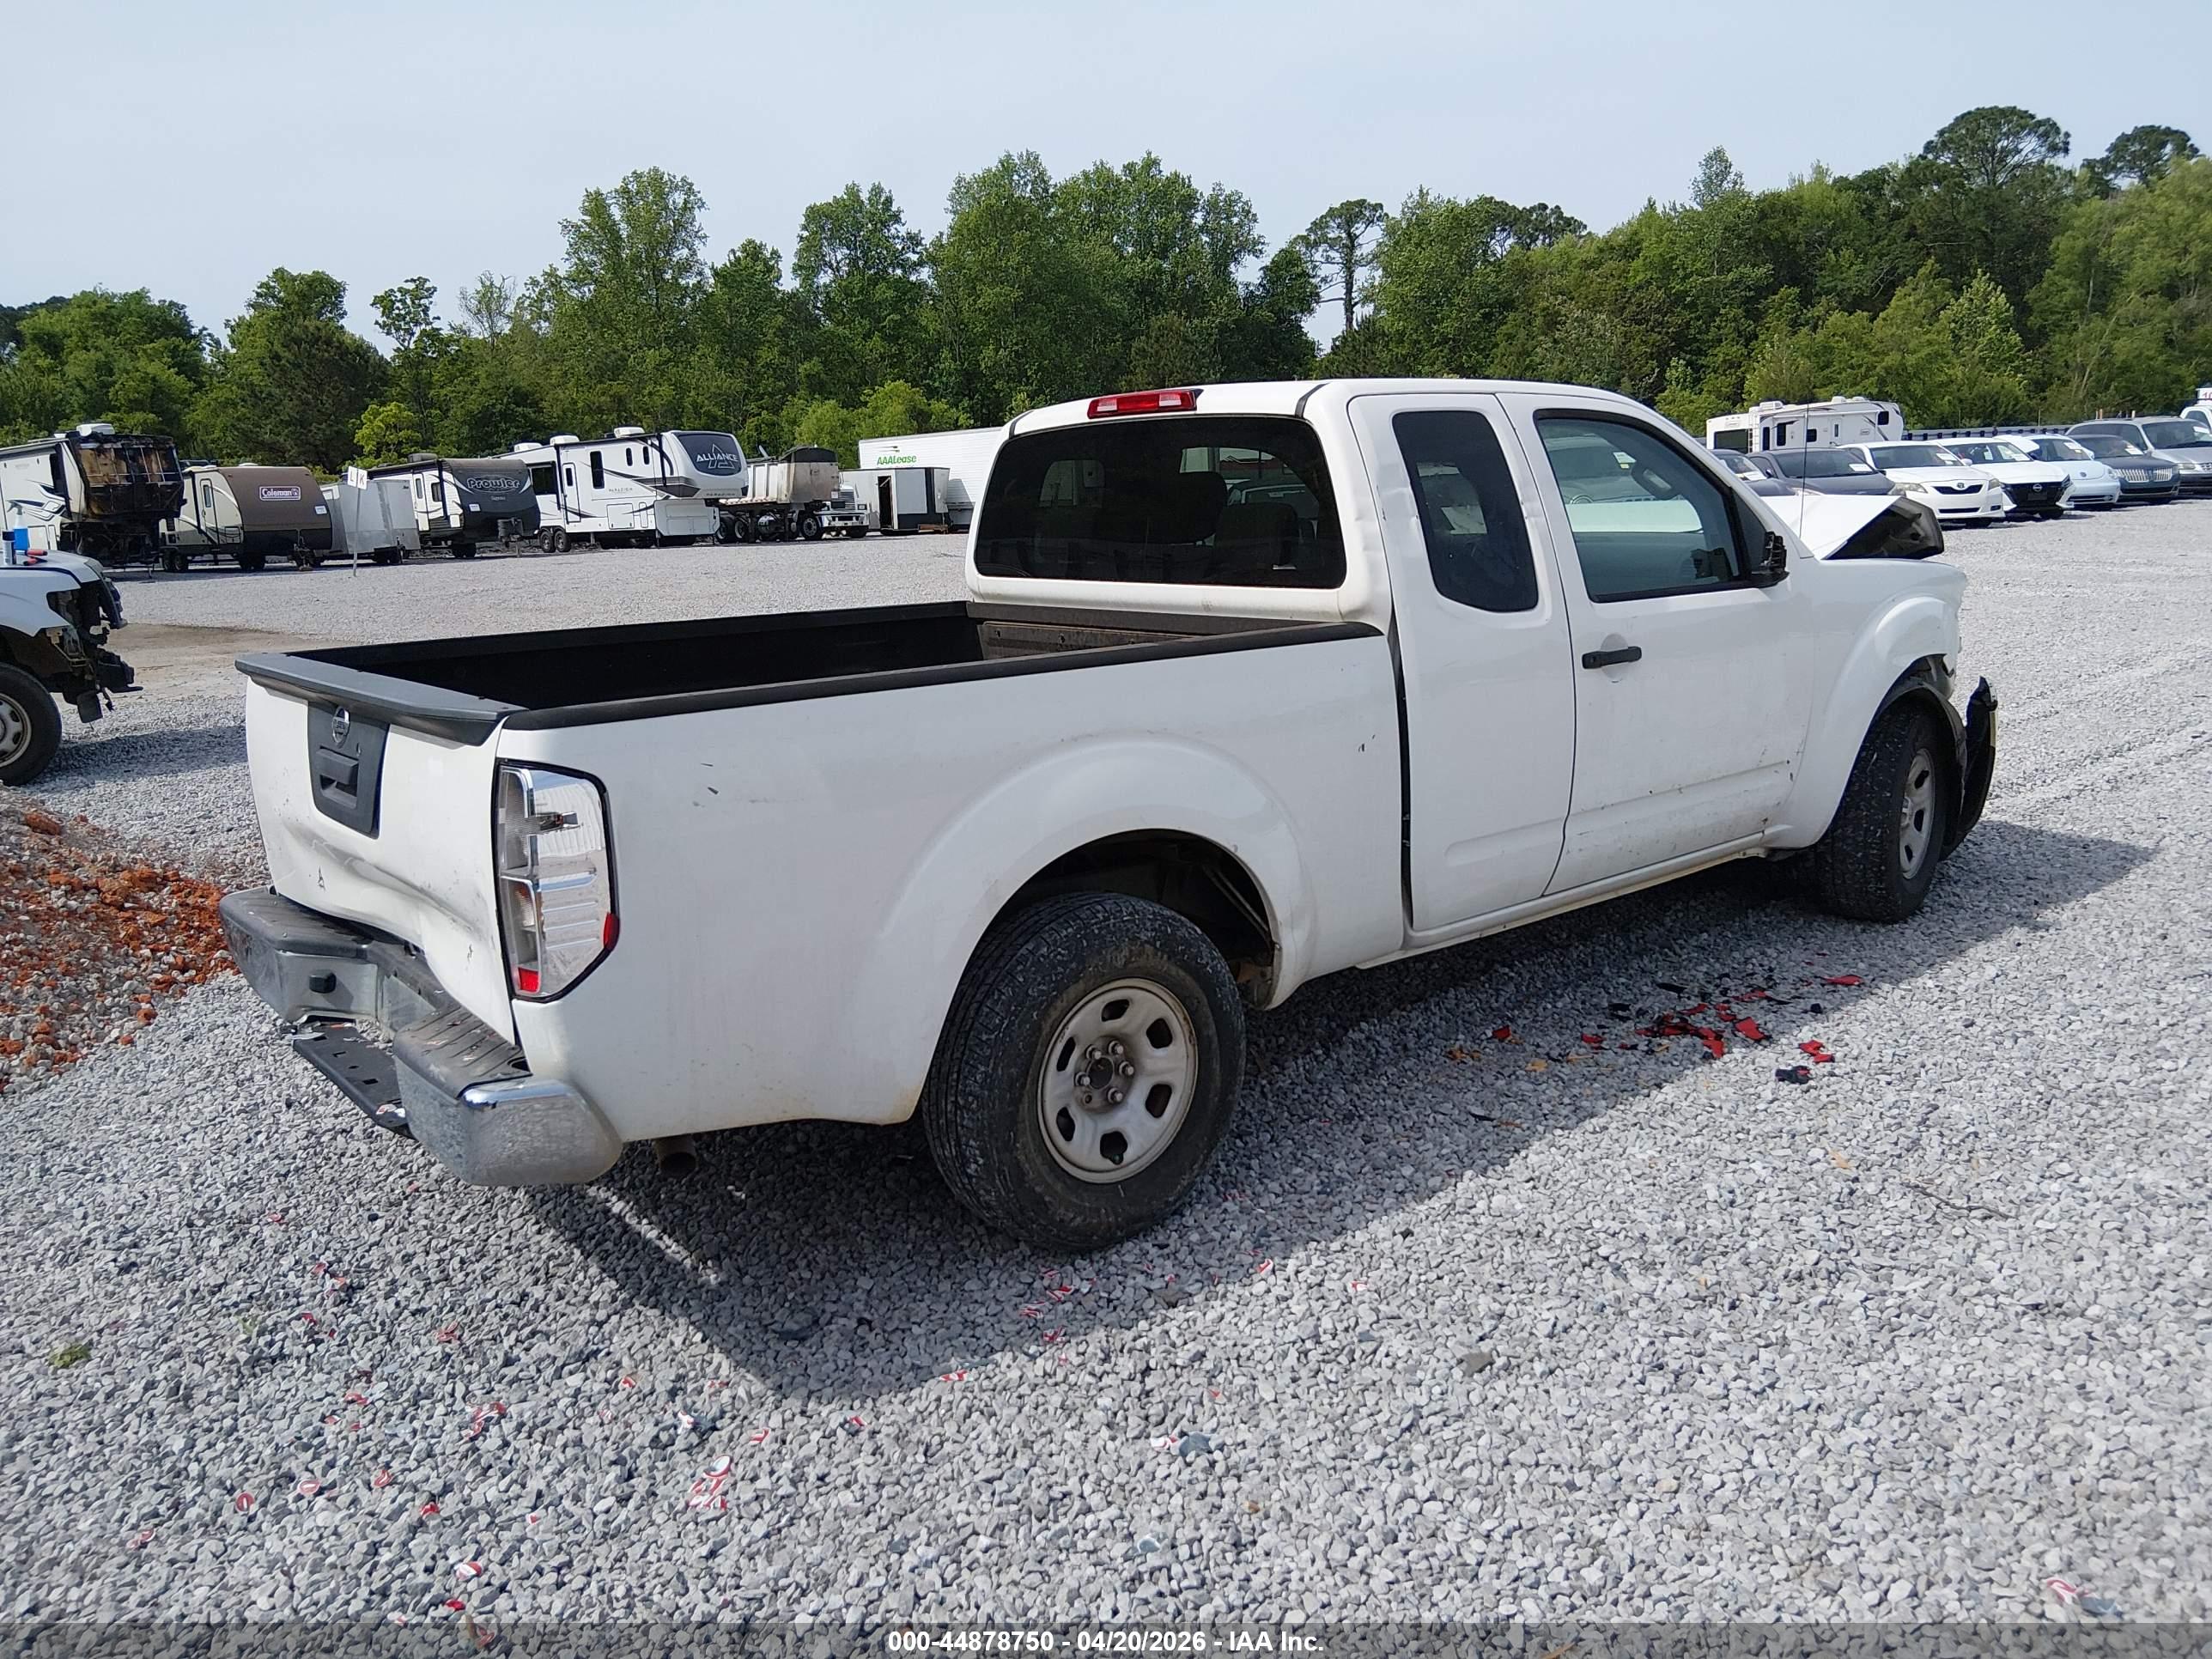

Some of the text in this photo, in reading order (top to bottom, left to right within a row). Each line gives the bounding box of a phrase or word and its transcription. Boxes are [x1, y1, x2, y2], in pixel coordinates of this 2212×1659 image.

[696, 453, 738, 463] ALLIANCE
[877, 455, 917, 465] AAALease
[359, 473, 365, 485] K
[466, 477, 520, 489] Prowler
[262, 488, 293, 497] Coleman
